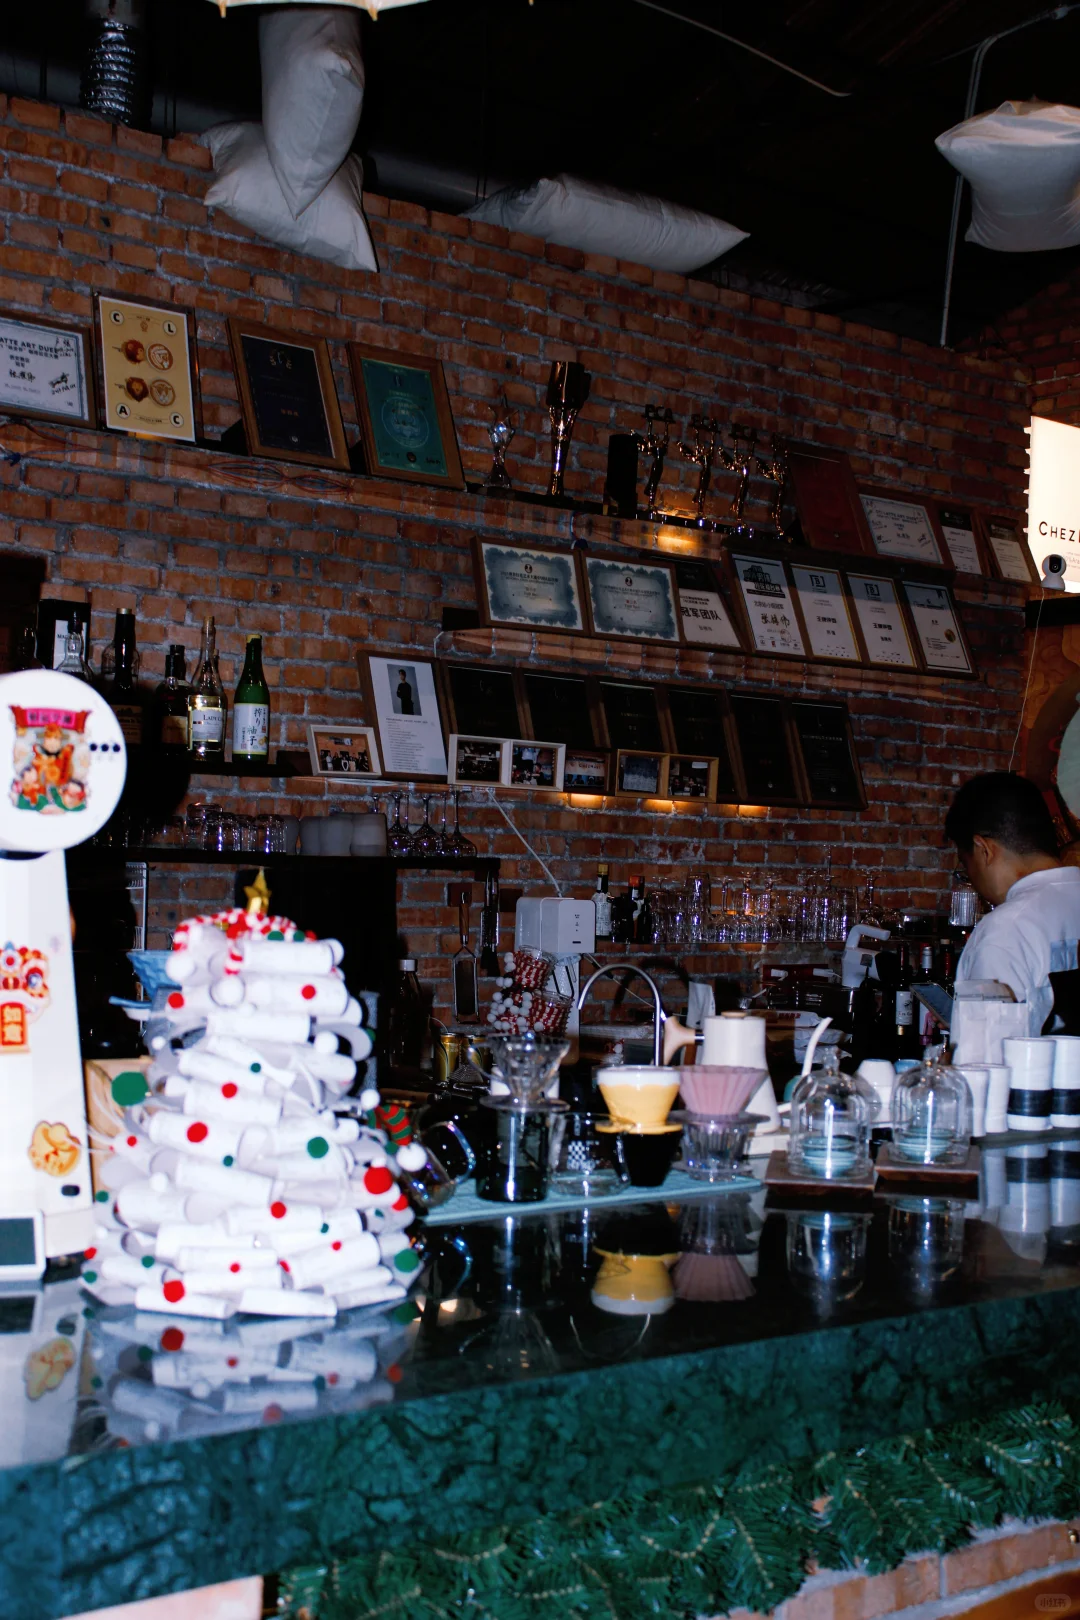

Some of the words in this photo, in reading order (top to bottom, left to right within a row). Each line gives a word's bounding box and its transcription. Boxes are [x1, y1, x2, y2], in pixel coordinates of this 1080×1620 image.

[113, 312, 121, 322] C
[167, 324, 174, 333] L
[21, 341, 36, 349] ART
[119, 405, 128, 416] A
[173, 414, 180, 424] C
[680, 606, 722, 621] 冠军团队
[247, 725, 257, 746] 柚子
